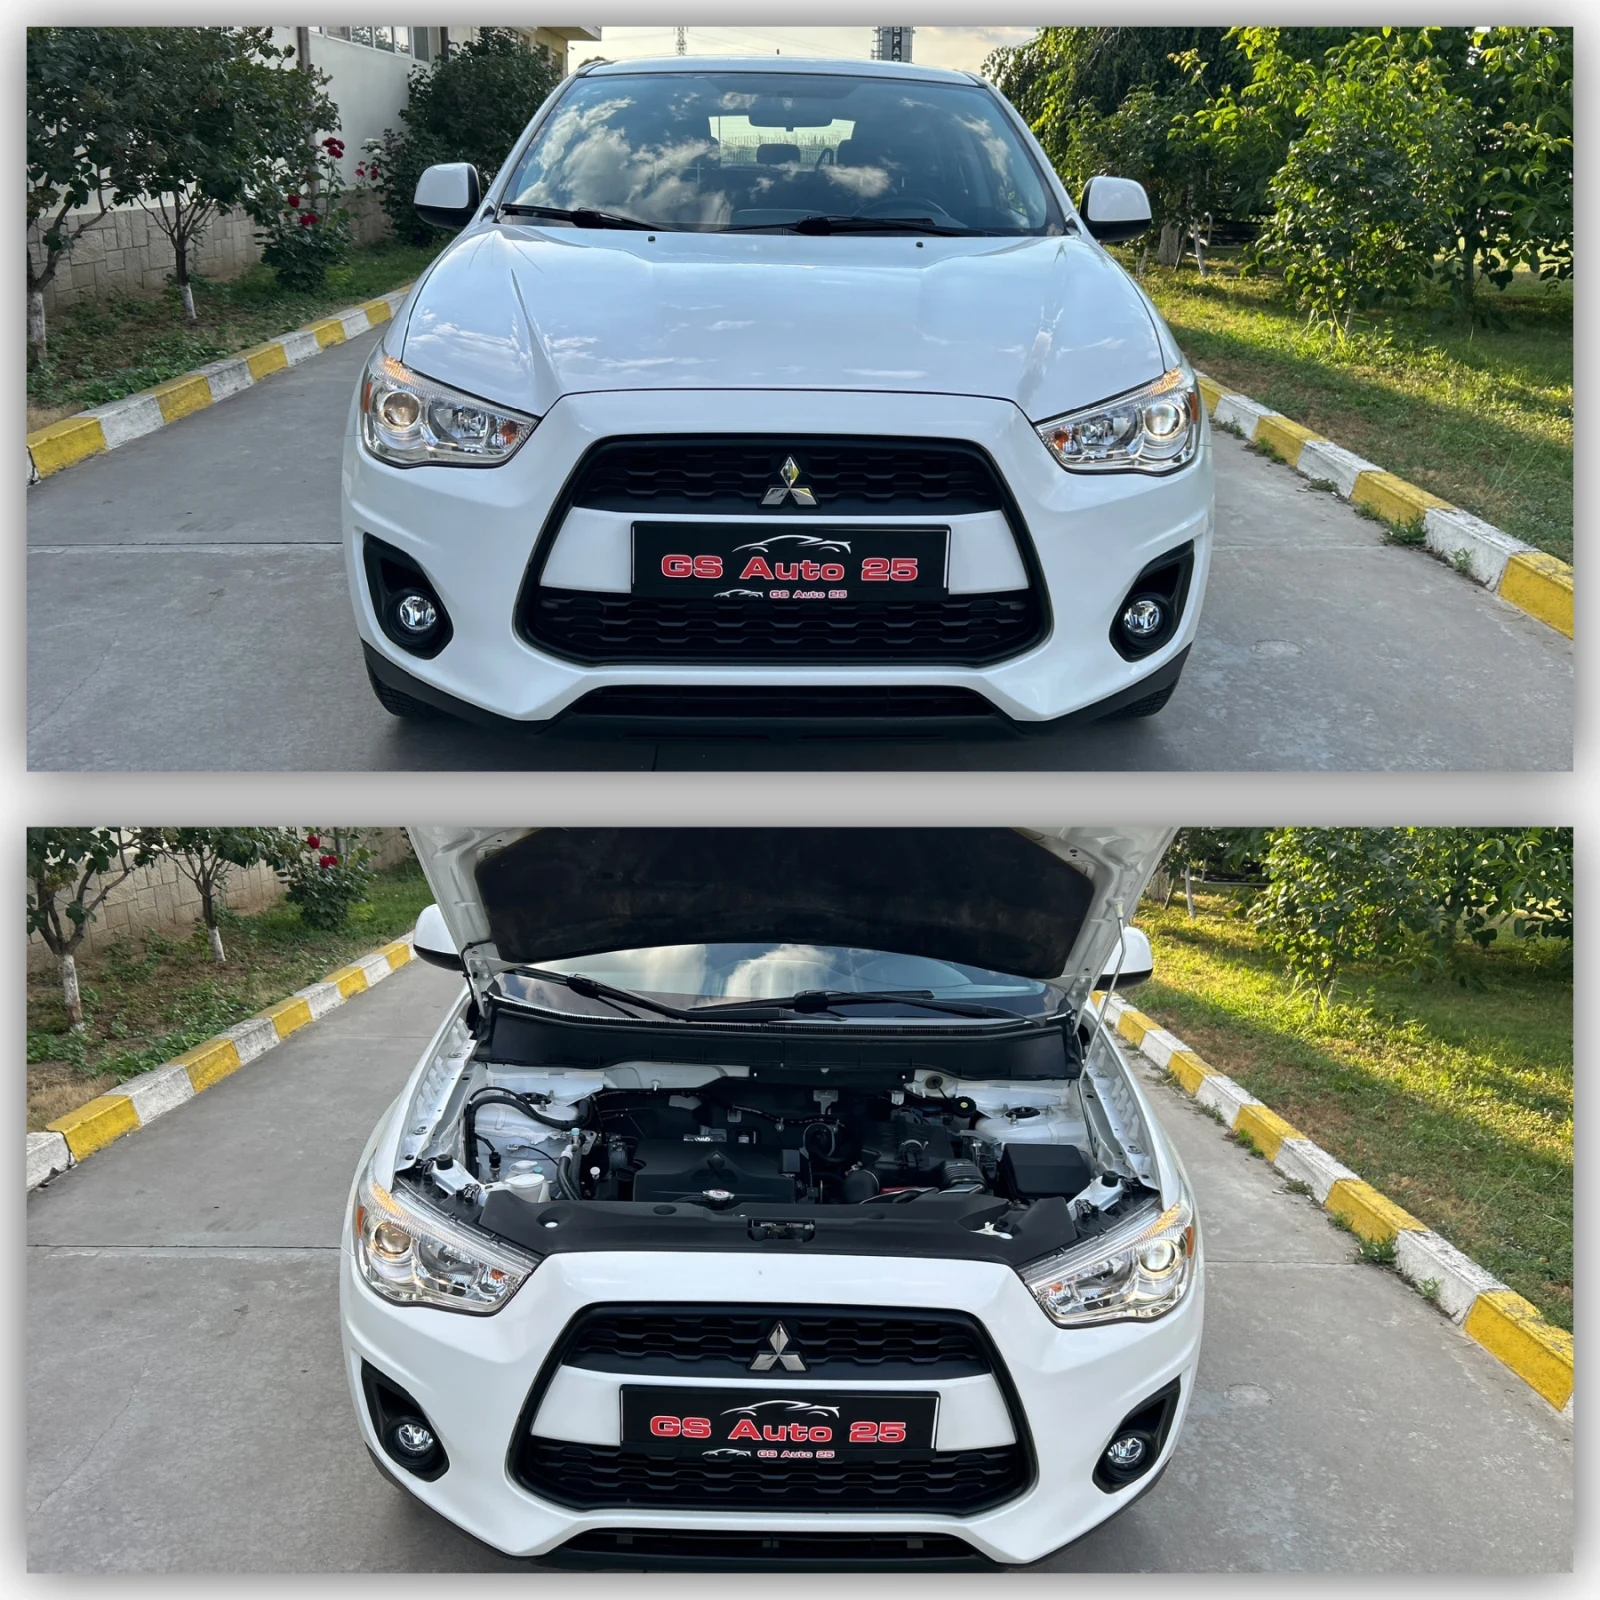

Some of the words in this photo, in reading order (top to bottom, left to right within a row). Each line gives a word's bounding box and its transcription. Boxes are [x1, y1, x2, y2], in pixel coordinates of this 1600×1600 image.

[661, 554, 723, 579] GS
[739, 556, 845, 581] Auto
[861, 557, 918, 582] 25
[769, 589, 790, 599] GS
[792, 589, 826, 599] Auto
[828, 589, 848, 599] 25
[650, 1415, 712, 1439] GS
[727, 1418, 833, 1442] Auto
[849, 1421, 906, 1443] 25
[757, 1449, 778, 1458] GS
[780, 1449, 813, 1459] Auto
[815, 1449, 835, 1459] 25
